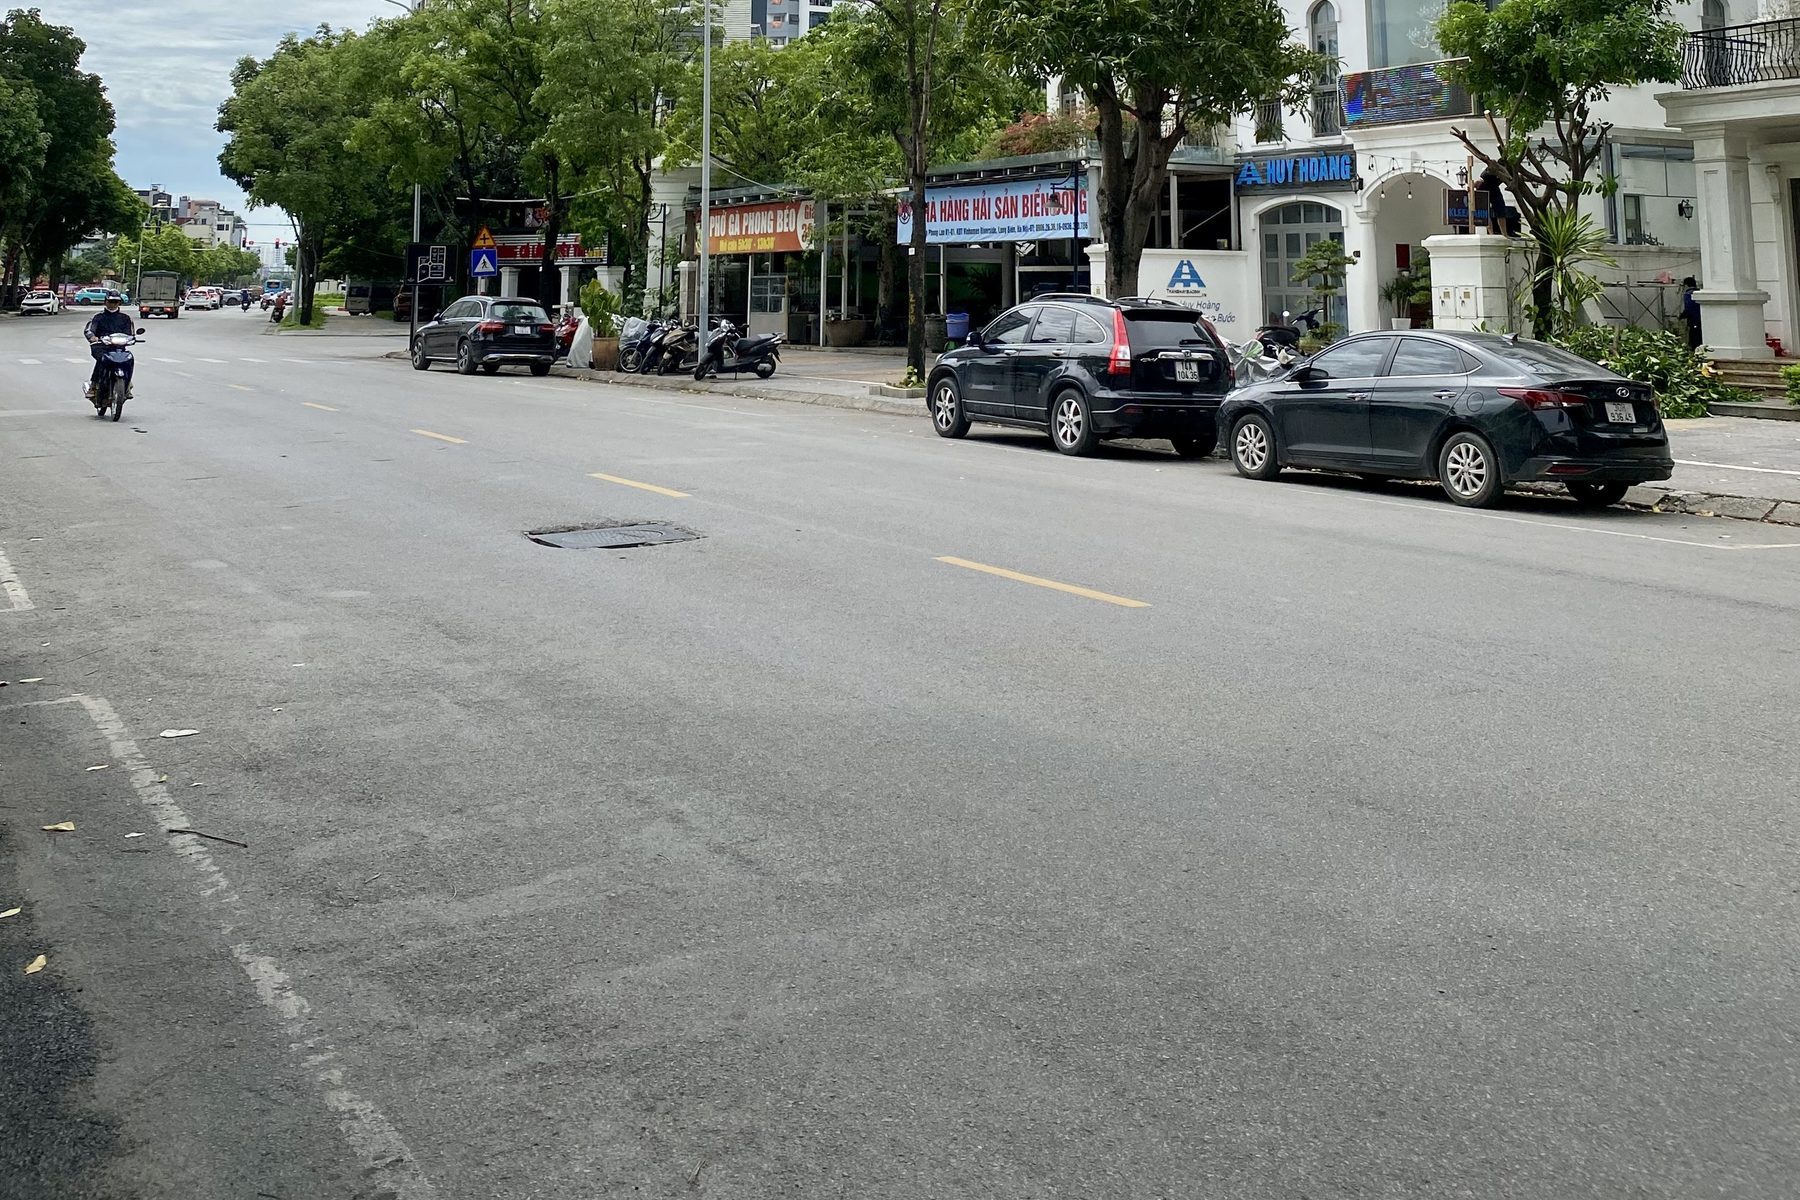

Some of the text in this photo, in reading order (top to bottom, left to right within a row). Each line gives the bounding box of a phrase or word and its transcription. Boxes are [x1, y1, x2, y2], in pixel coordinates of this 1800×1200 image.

[1267, 150, 1352, 184] HUY HOÀNG
[925, 196, 937, 223] HÀ
[940, 194, 969, 222] HÀNG
[972, 189, 991, 220] HẢI
[994, 187, 1018, 220] SẢN
[1022, 183, 1049, 218] BIỂN
[709, 206, 796, 237] PHỞ GÀ PHONG BÉO
[1196, 300, 1221, 311] Hoàng
[1217, 312, 1236, 323] Bước
